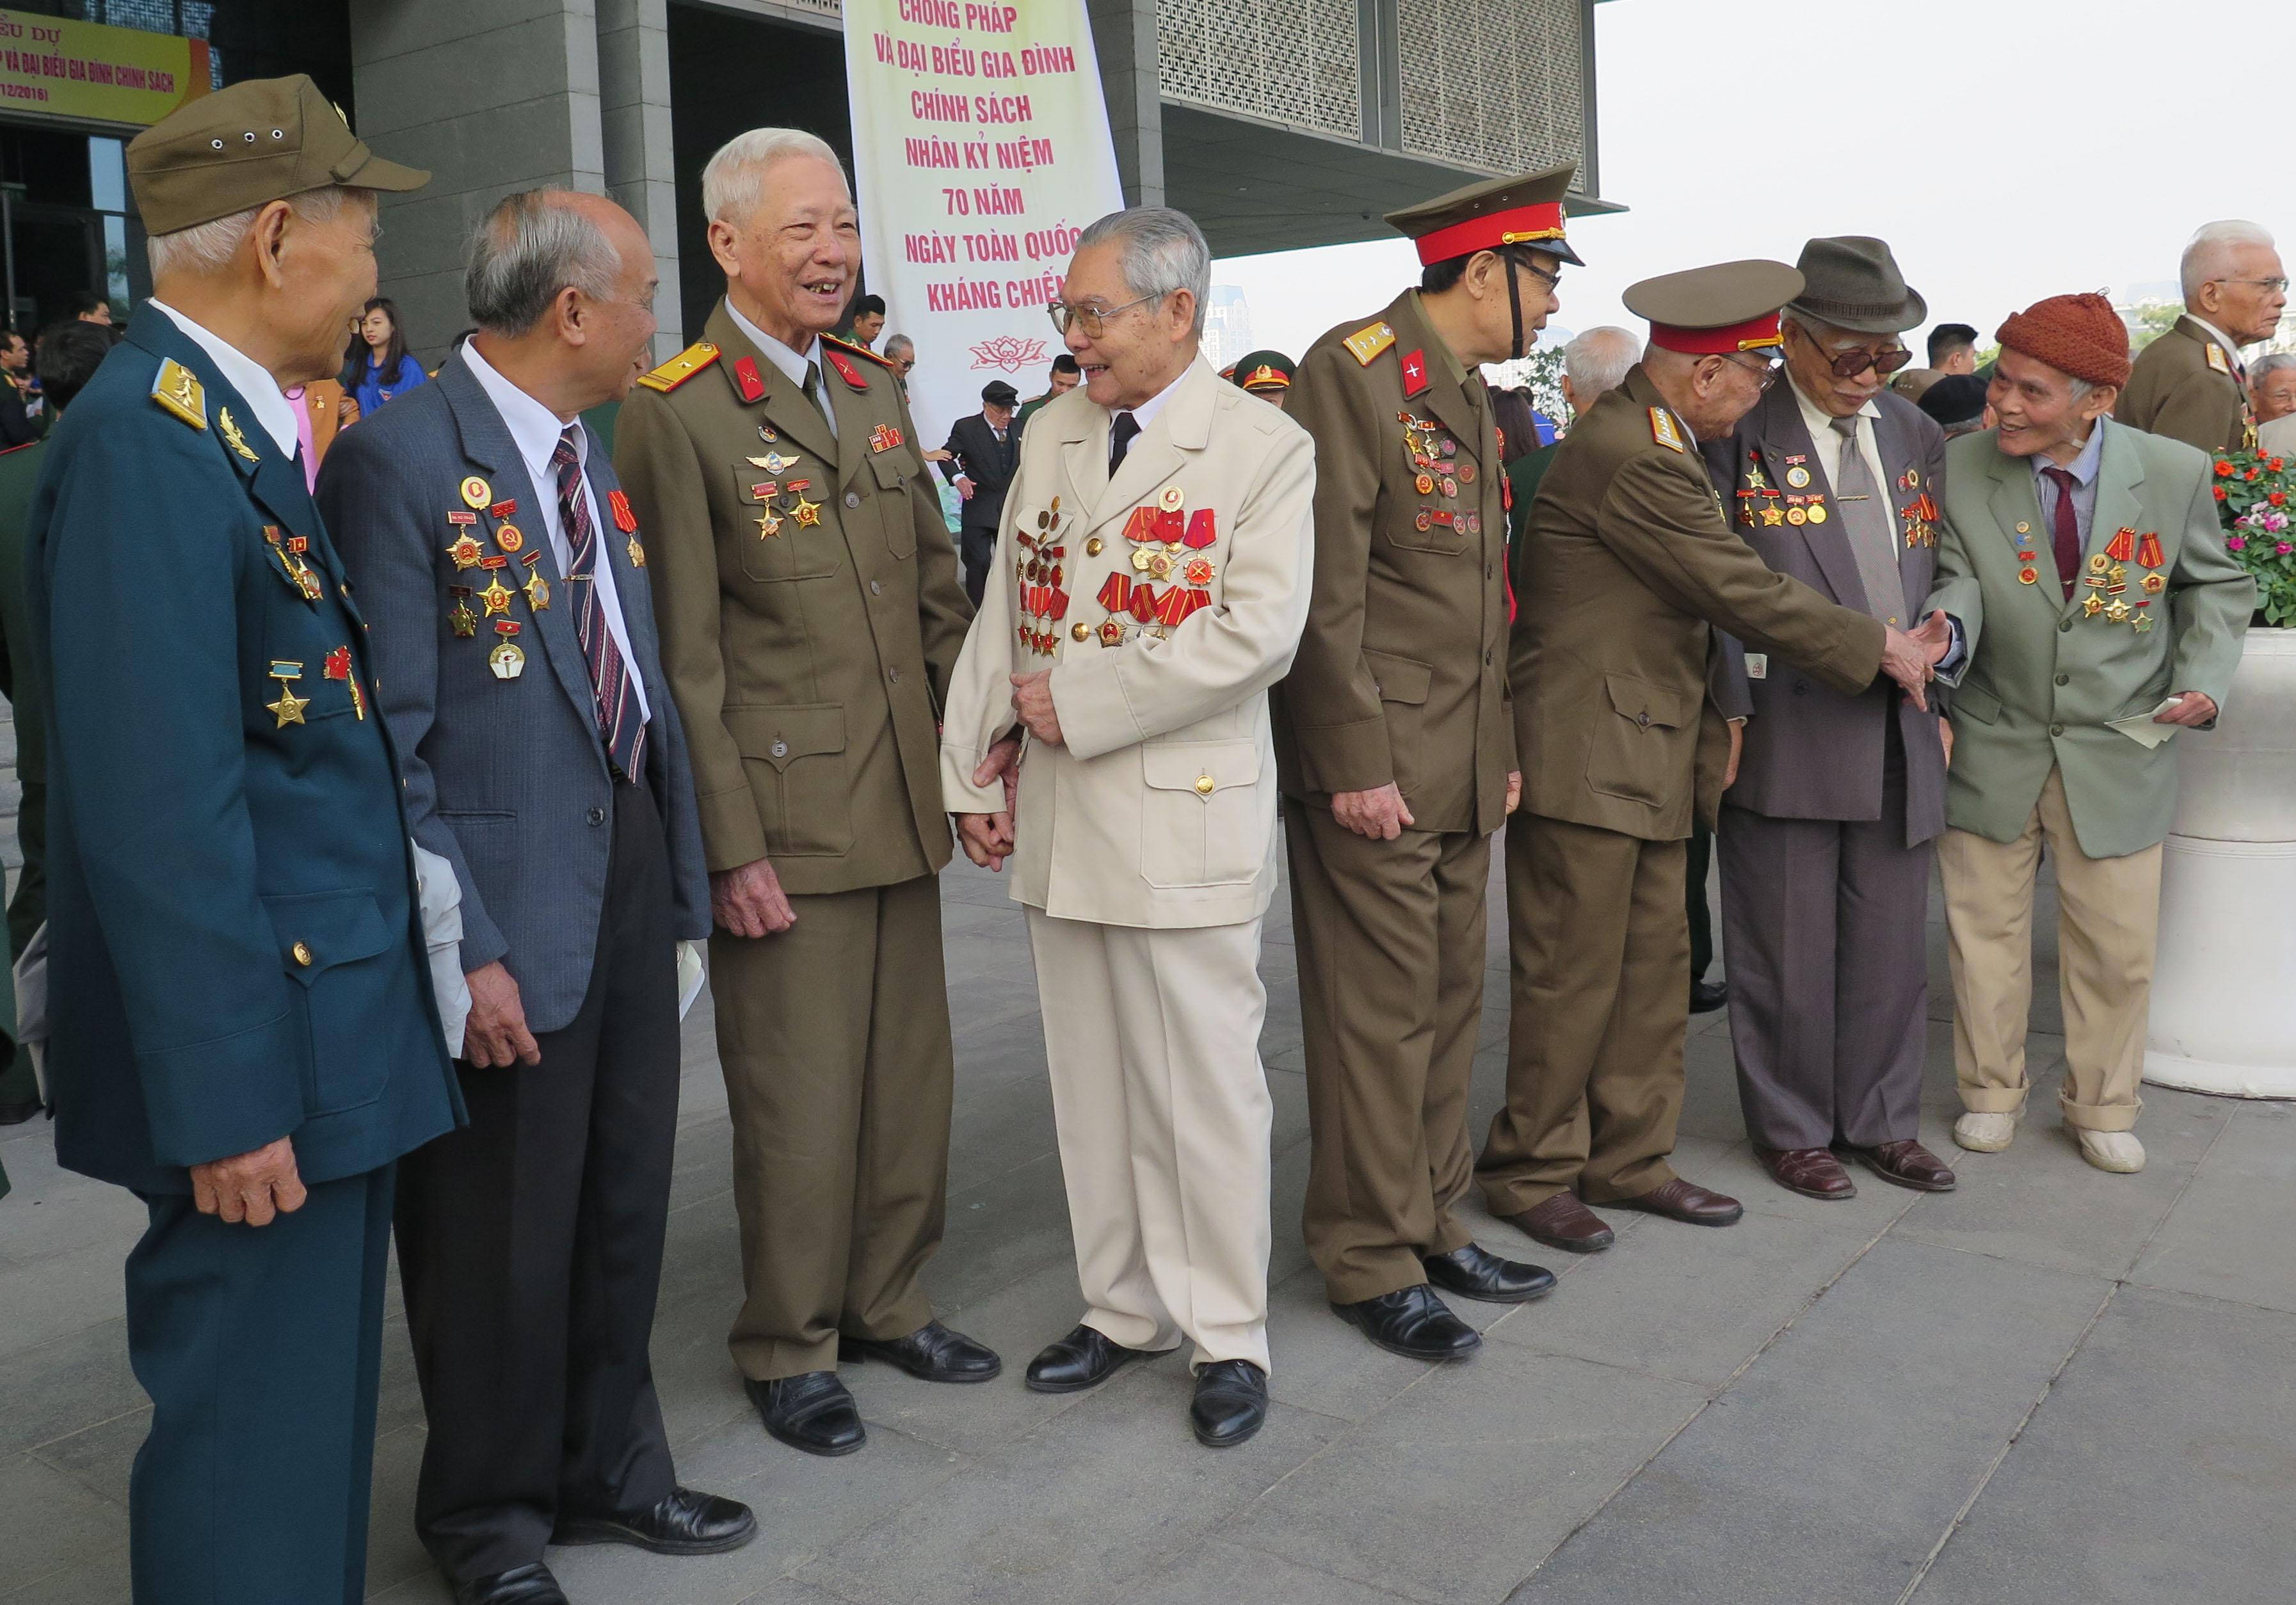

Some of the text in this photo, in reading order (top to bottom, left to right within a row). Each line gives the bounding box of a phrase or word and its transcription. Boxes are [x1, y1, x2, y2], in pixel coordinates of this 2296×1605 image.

[965, 1, 1017, 33] PHÁP
[69, 59, 86, 81] GIA
[874, 29, 1075, 78] VÀ ĐẠI BIỂU GIA ĐÌNH
[911, 88, 1032, 124] CHÍNH SÁCH
[905, 131, 1054, 173] NHÂN KỶ NIỆM
[942, 182, 1025, 216] 70 NĂM
[904, 230, 956, 264] NGÀY
[963, 228, 1019, 262] TOÀN
[927, 276, 1001, 312] KHÁNG
